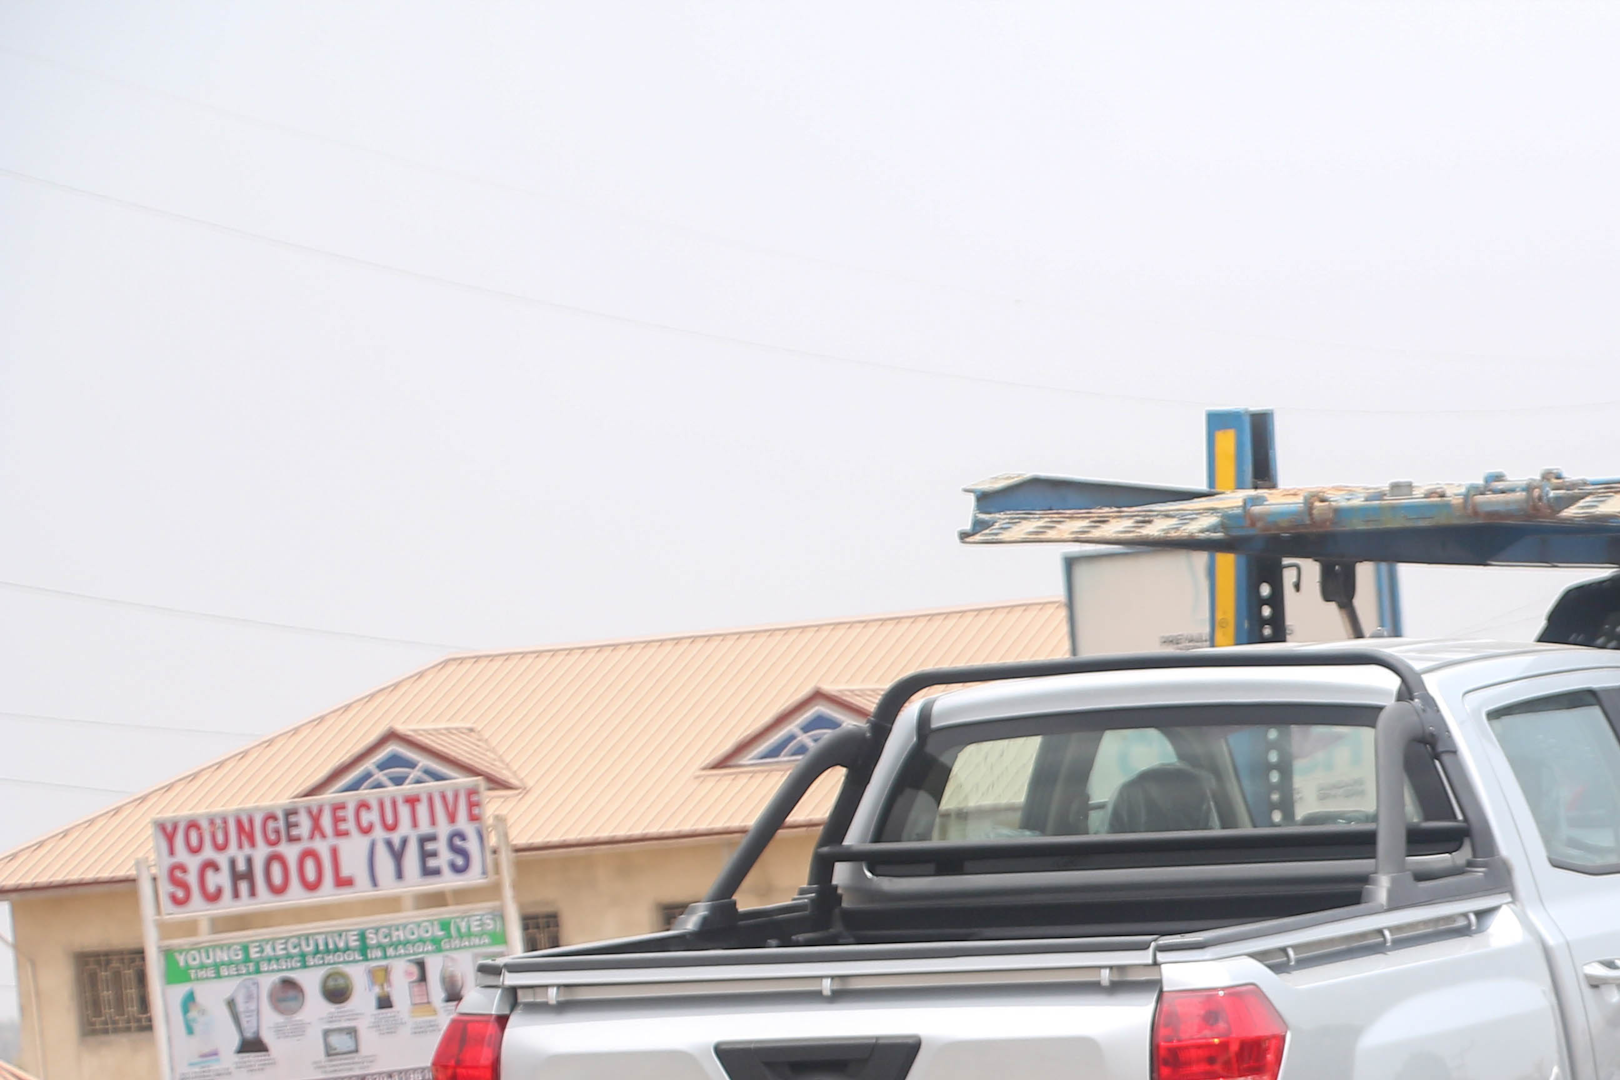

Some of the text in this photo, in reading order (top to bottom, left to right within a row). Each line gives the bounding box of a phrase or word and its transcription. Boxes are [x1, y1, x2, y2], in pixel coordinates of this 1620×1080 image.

[167, 825, 488, 907] SCHOOL (YES)
[173, 912, 503, 968] YOUNG EXECUTIVE SCHOOL (YES)
[188, 967, 216, 981] THE
[220, 962, 255, 977] BEST
[259, 955, 301, 972] BASIC
[305, 950, 363, 966] SCHOOL
[366, 948, 382, 960] IN
[440, 934, 491, 950] GHANA
